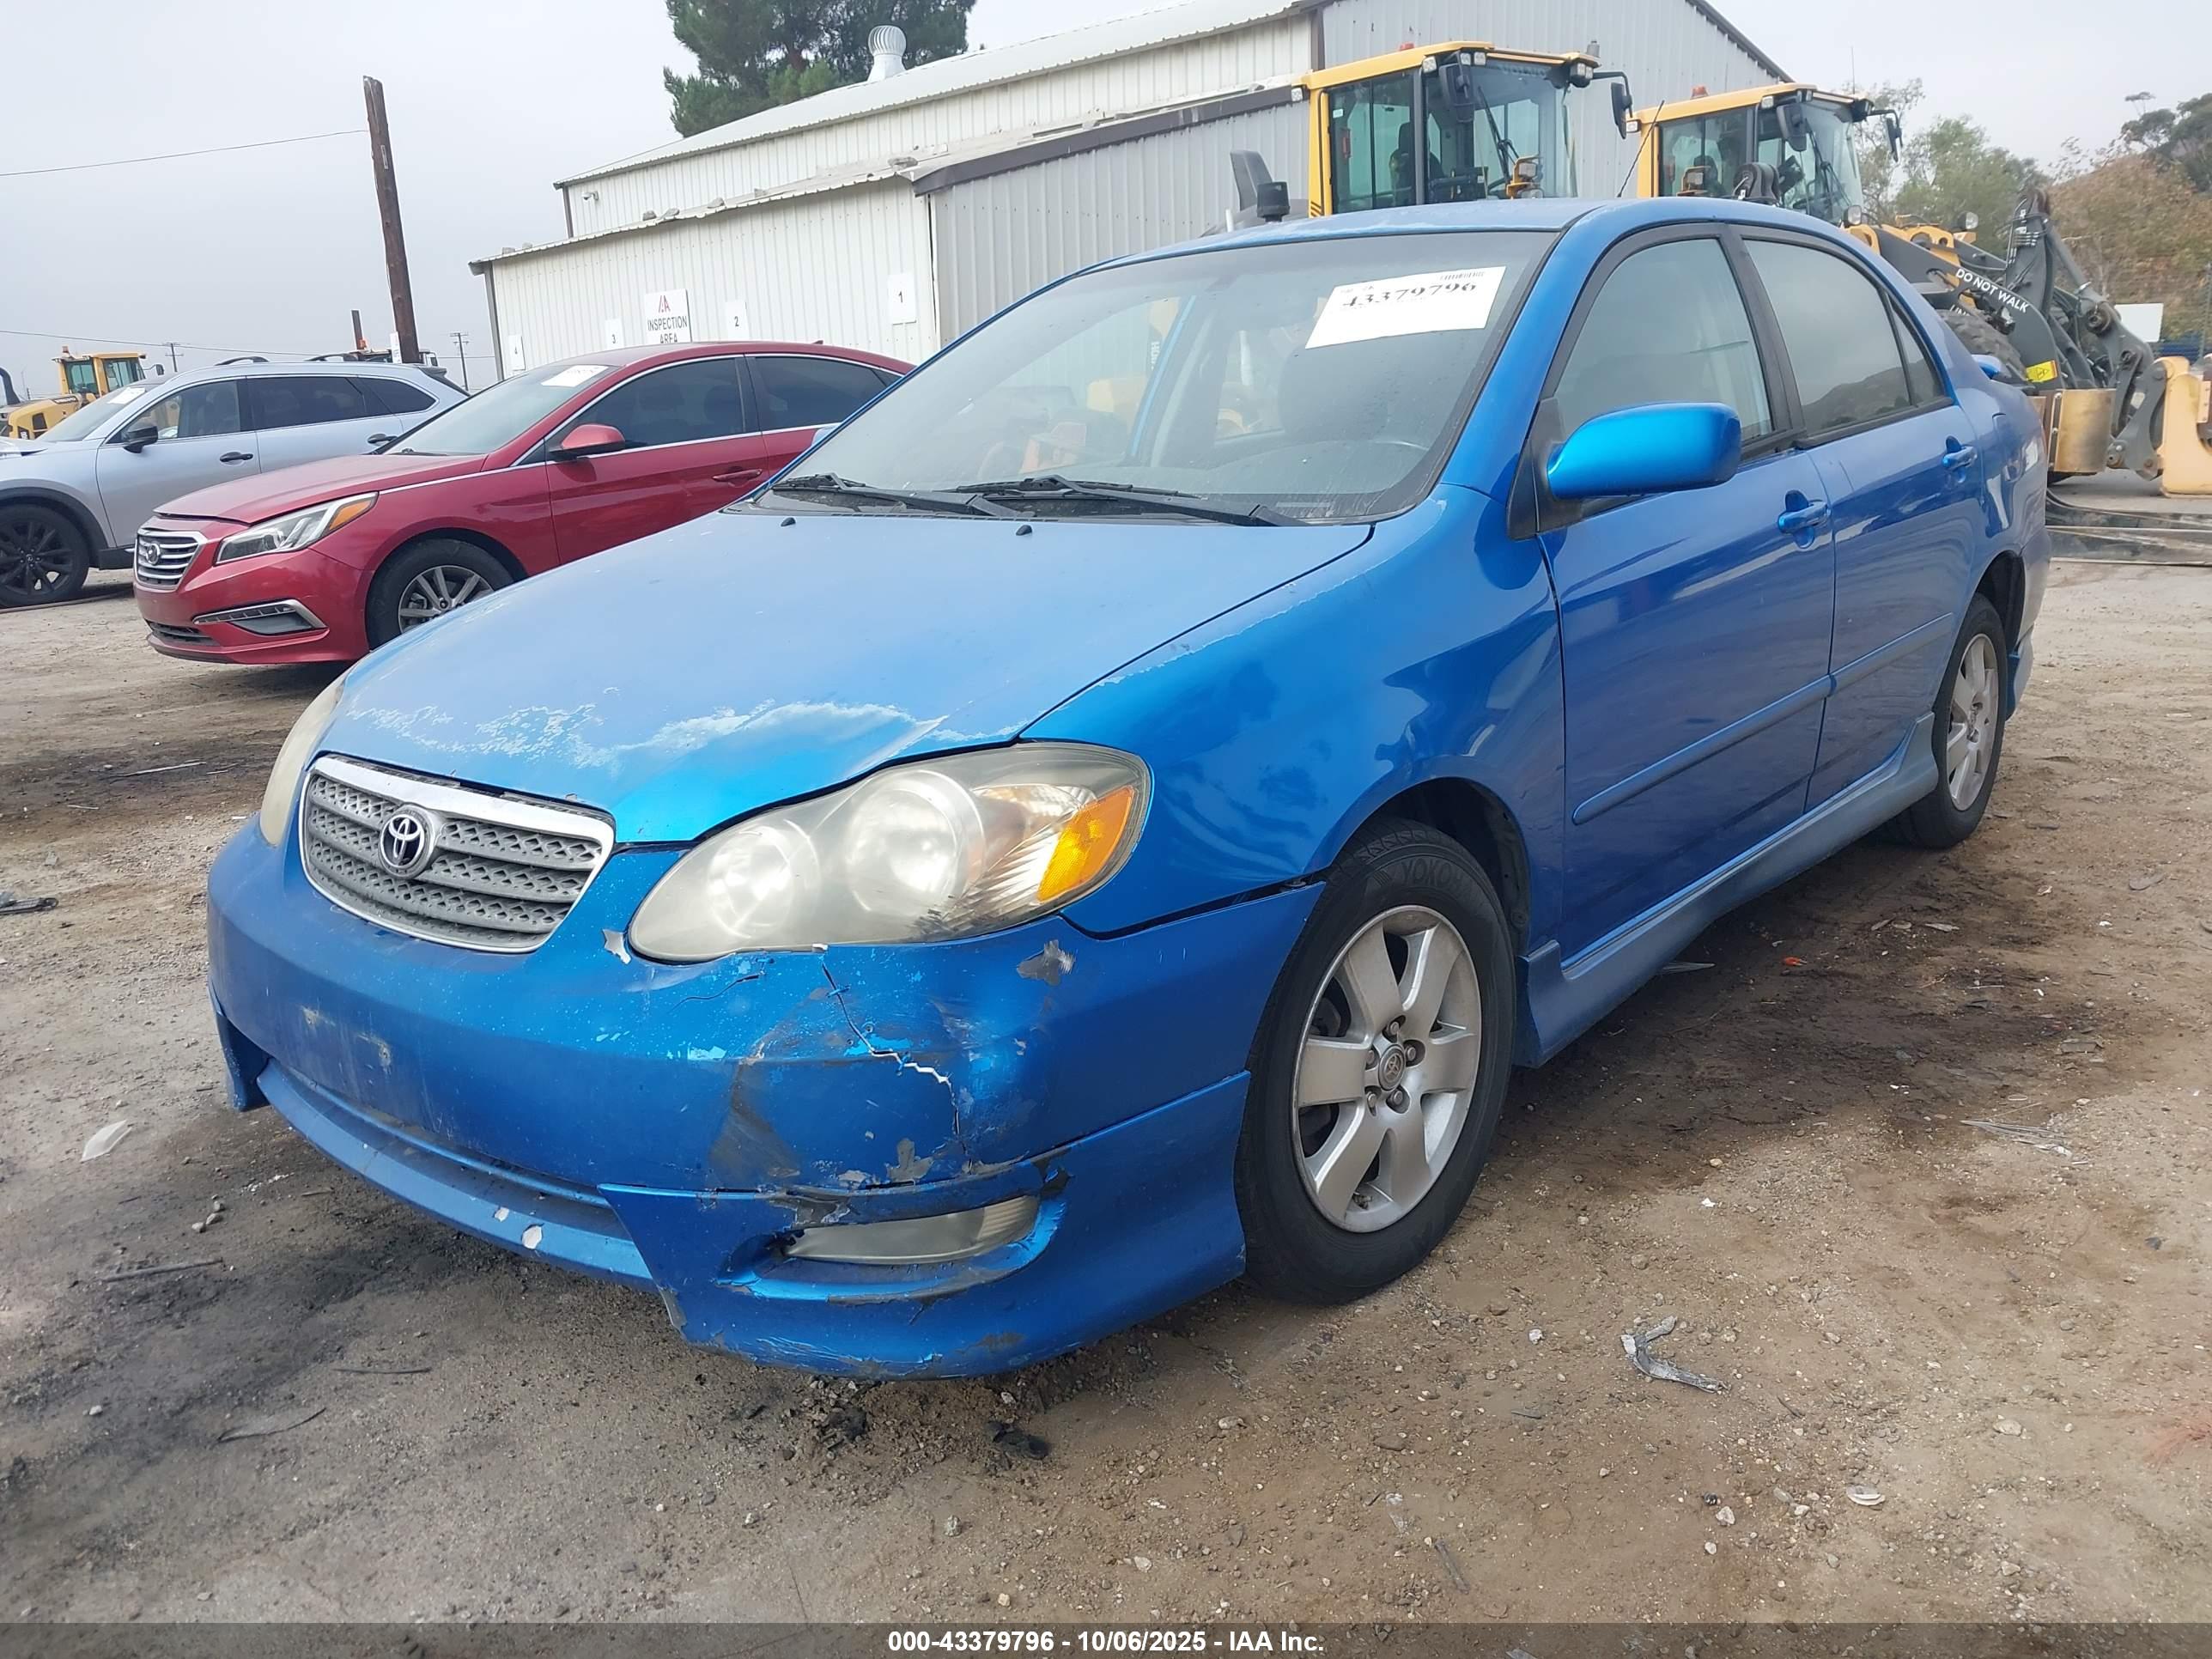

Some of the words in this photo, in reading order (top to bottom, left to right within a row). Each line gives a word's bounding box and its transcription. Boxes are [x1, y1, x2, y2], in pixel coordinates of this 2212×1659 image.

[897, 291, 904, 303] 1
[1341, 283, 1477, 307] 43379796
[1955, 268, 1973, 283] DO
[1973, 276, 1998, 295] NOT
[1998, 289, 2029, 313] WALK
[647, 315, 688, 331] INSPECTION
[733, 315, 739, 327] 2
[611, 334, 617, 344] 3
